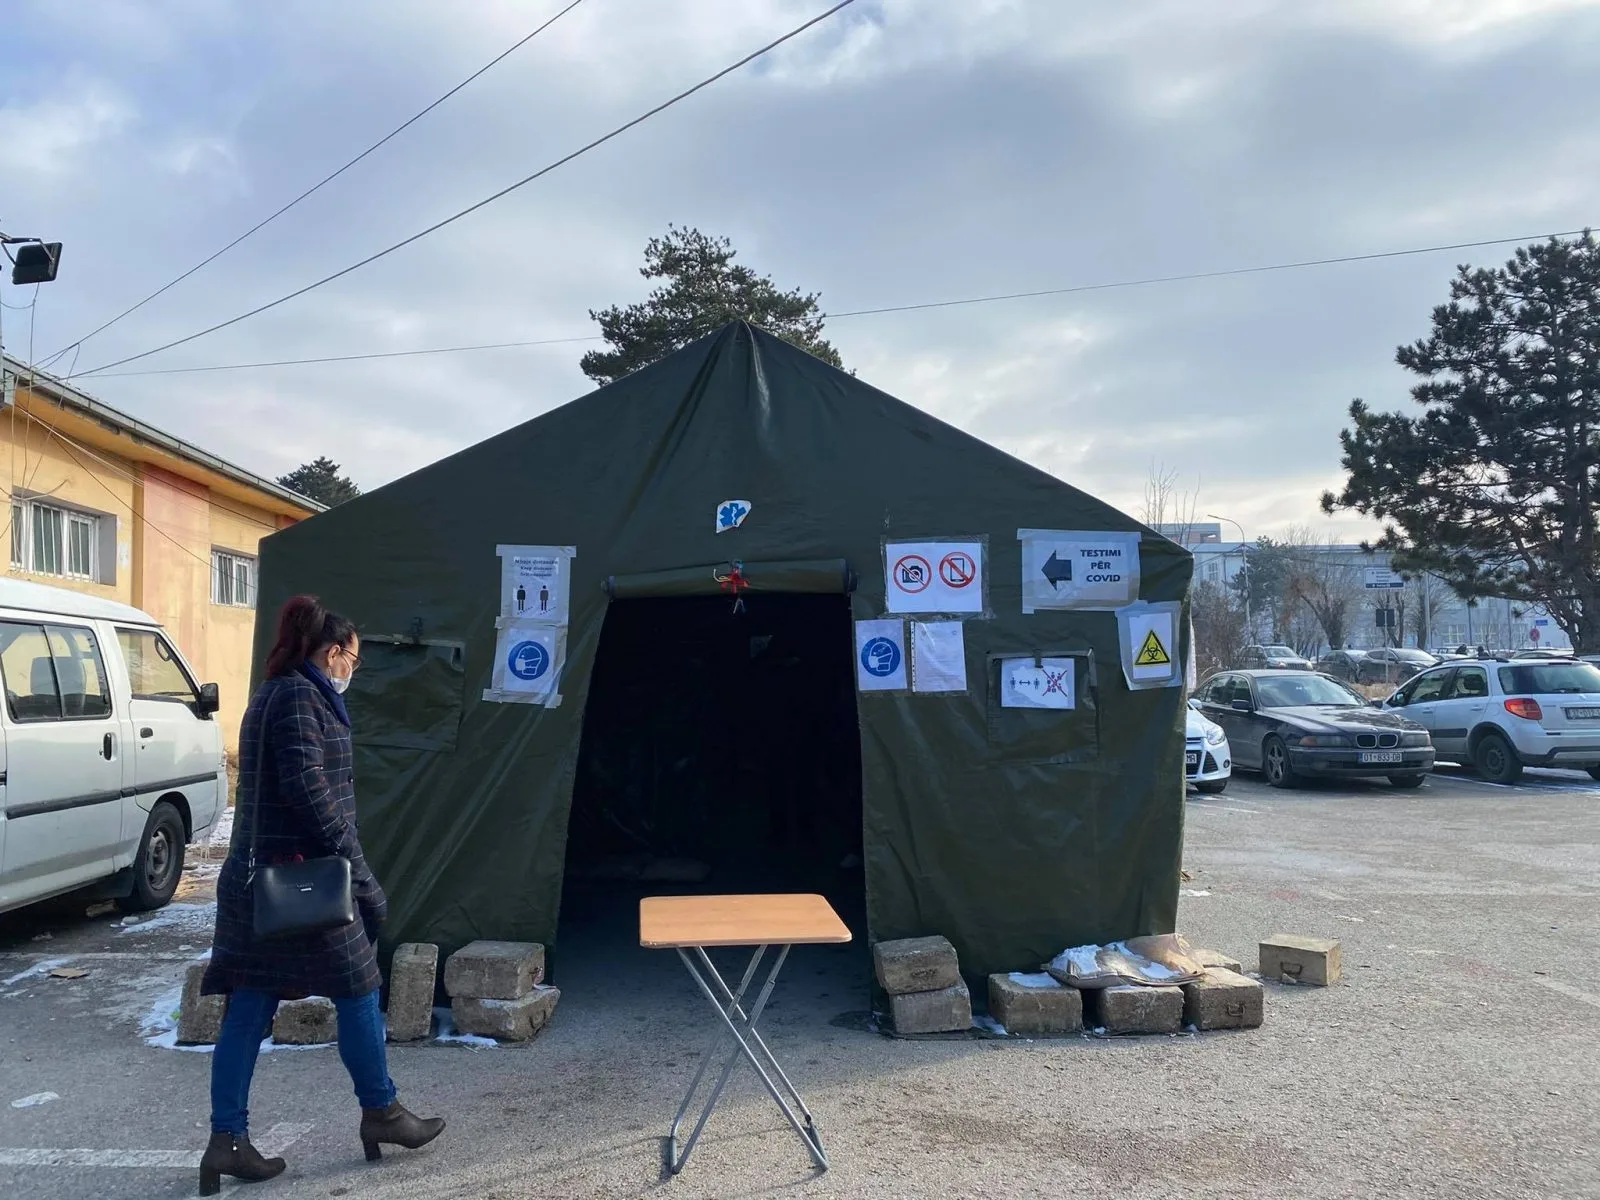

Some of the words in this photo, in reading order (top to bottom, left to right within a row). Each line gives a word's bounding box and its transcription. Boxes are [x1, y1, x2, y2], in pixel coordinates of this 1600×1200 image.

[1080, 549, 1121, 557] TESTIMI
[1090, 560, 1111, 570] PËR
[1086, 574, 1121, 582] COVID
